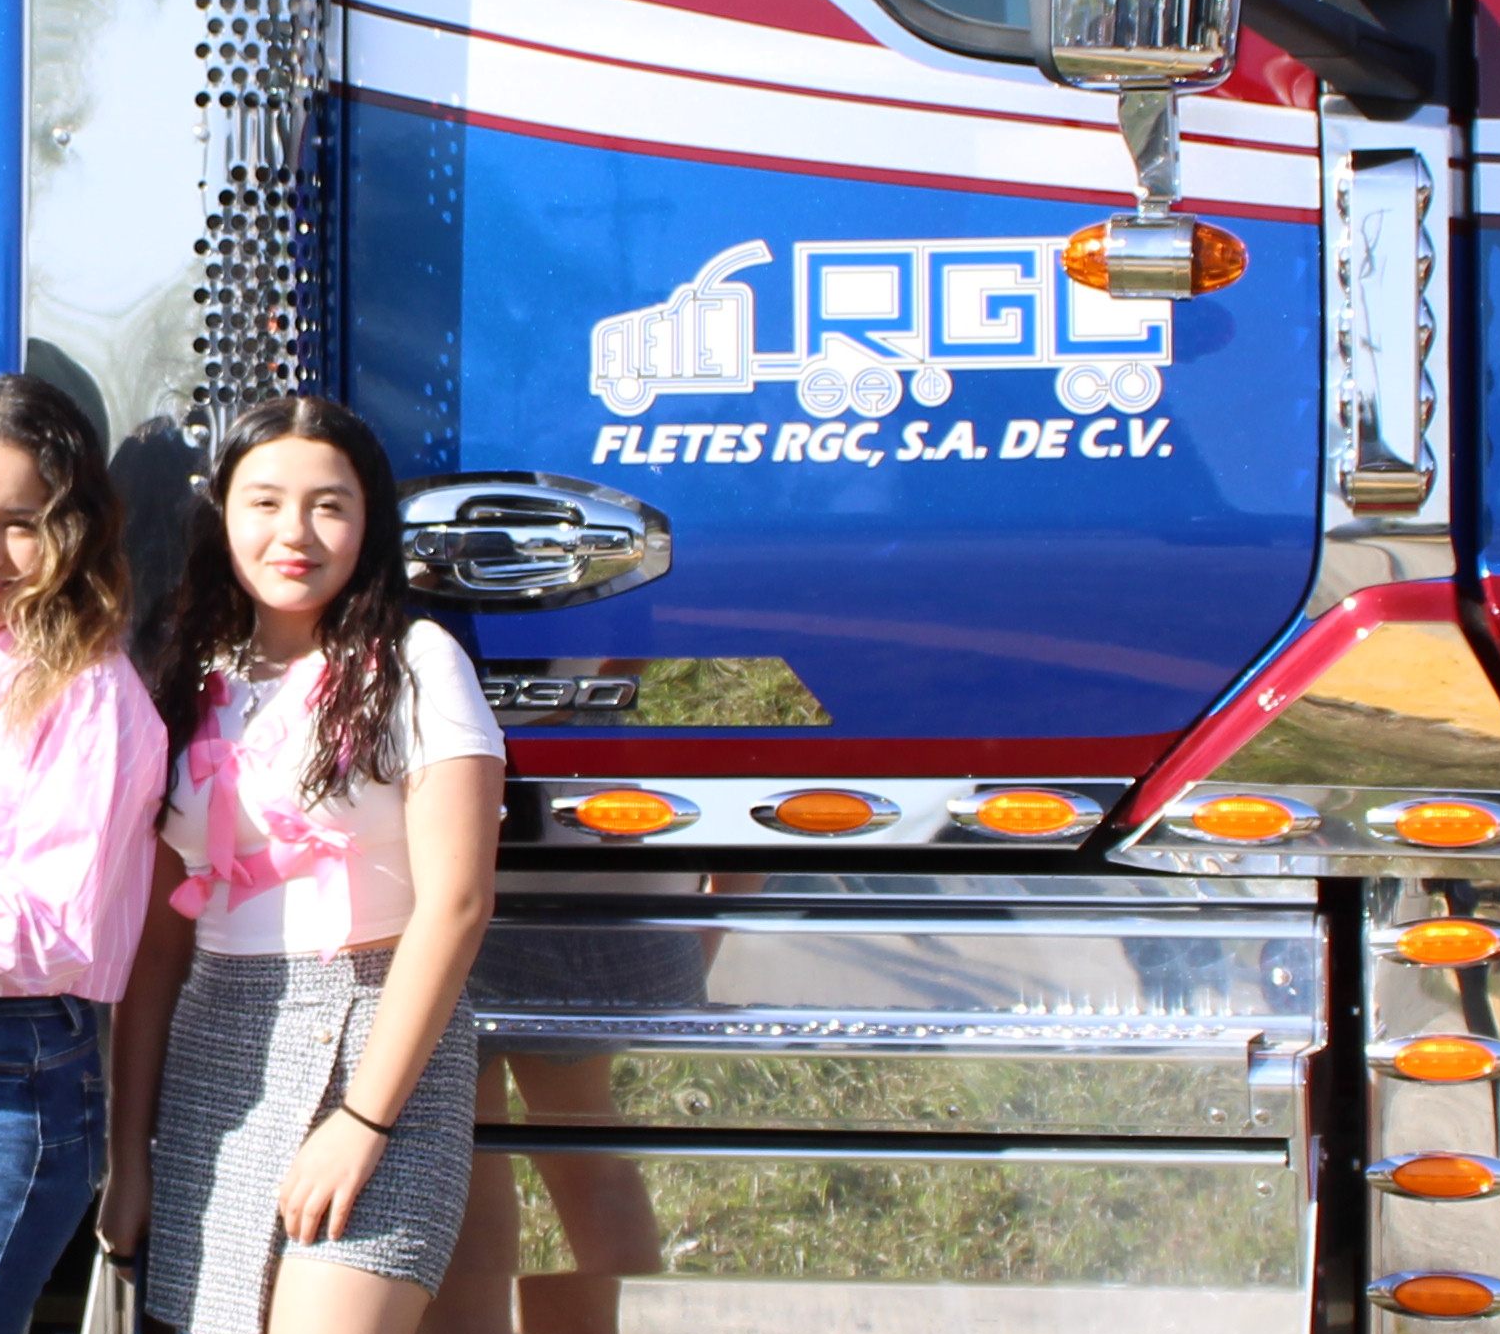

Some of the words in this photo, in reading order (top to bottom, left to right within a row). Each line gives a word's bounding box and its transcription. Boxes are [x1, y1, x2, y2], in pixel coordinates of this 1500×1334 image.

[592, 423, 768, 465] FLETES
[772, 421, 886, 466] RGC,
[895, 420, 990, 460] S.A.
[998, 419, 1075, 460] DE
[1078, 417, 1174, 459] C.V.
